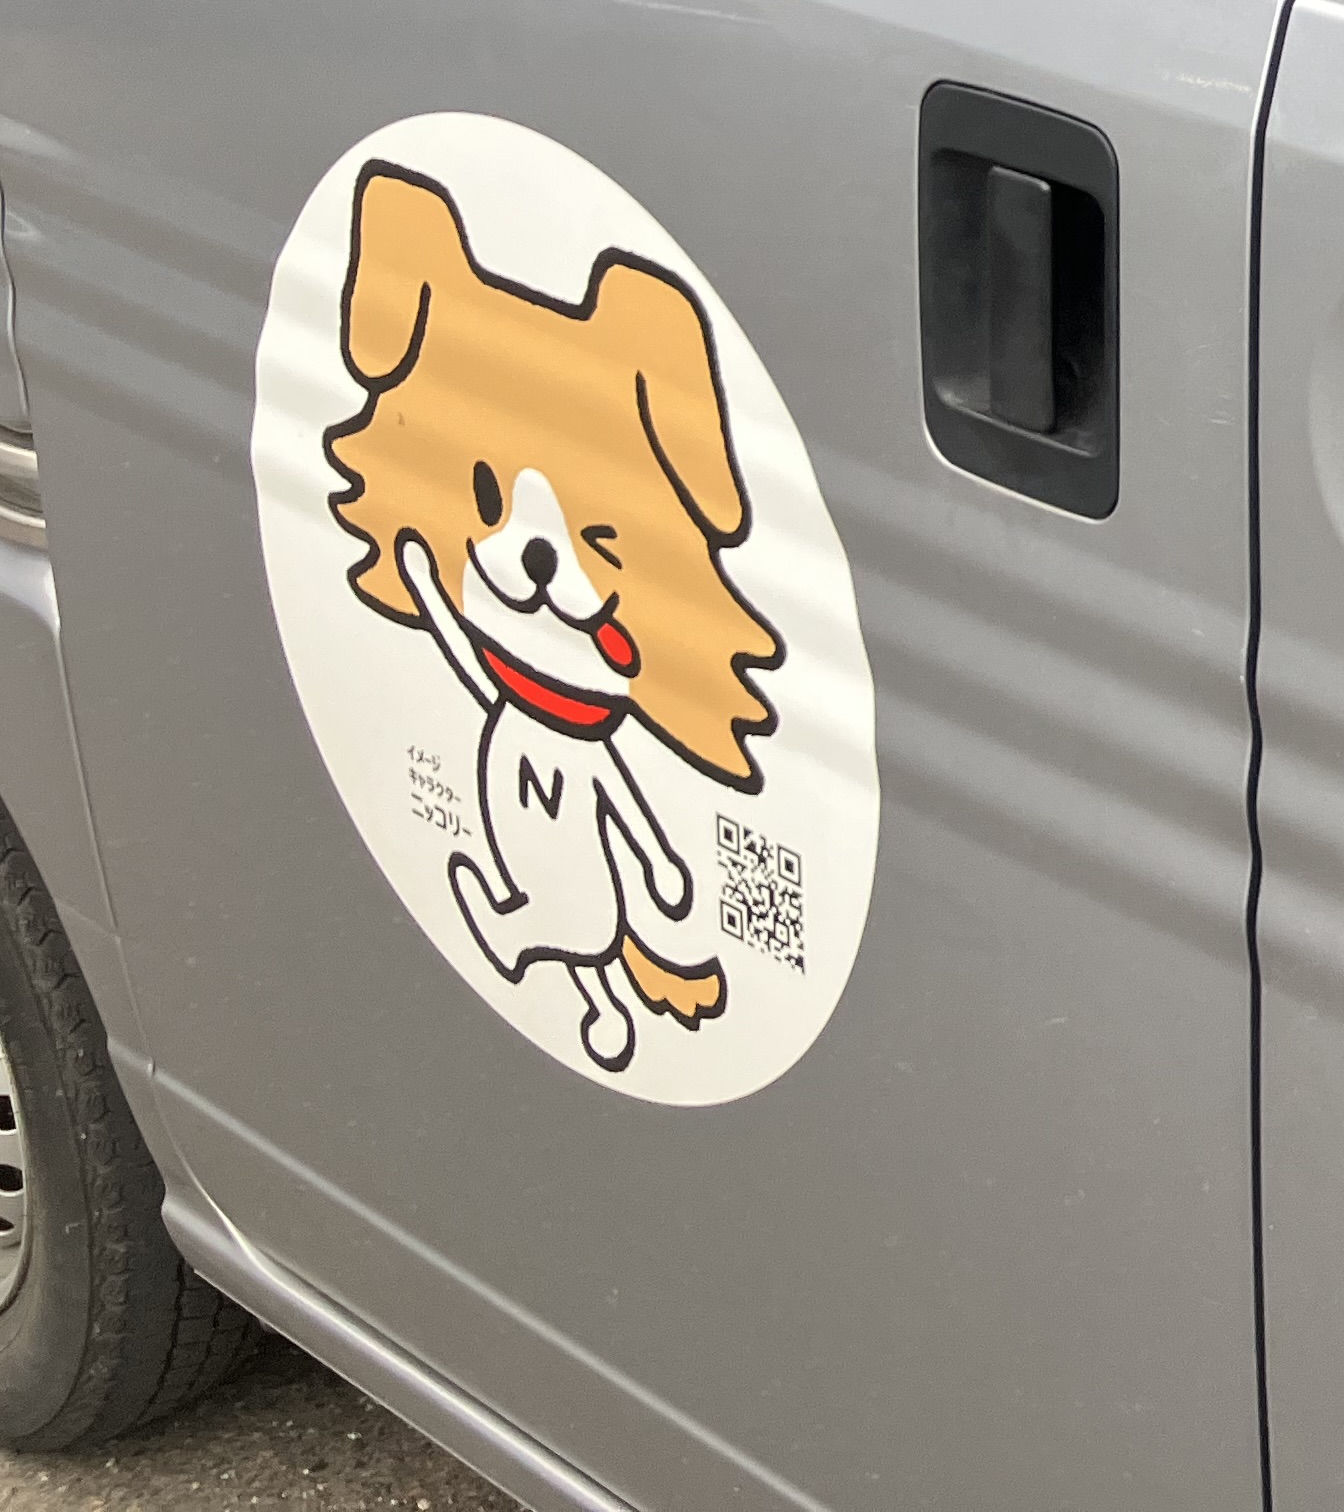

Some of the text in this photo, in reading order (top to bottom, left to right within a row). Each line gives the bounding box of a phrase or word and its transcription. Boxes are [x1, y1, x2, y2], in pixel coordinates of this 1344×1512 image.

[408, 745, 441, 772] イメージ
[408, 767, 462, 803] キャラクター
[519, 753, 564, 821] N
[410, 792, 474, 838] ニッコリー
